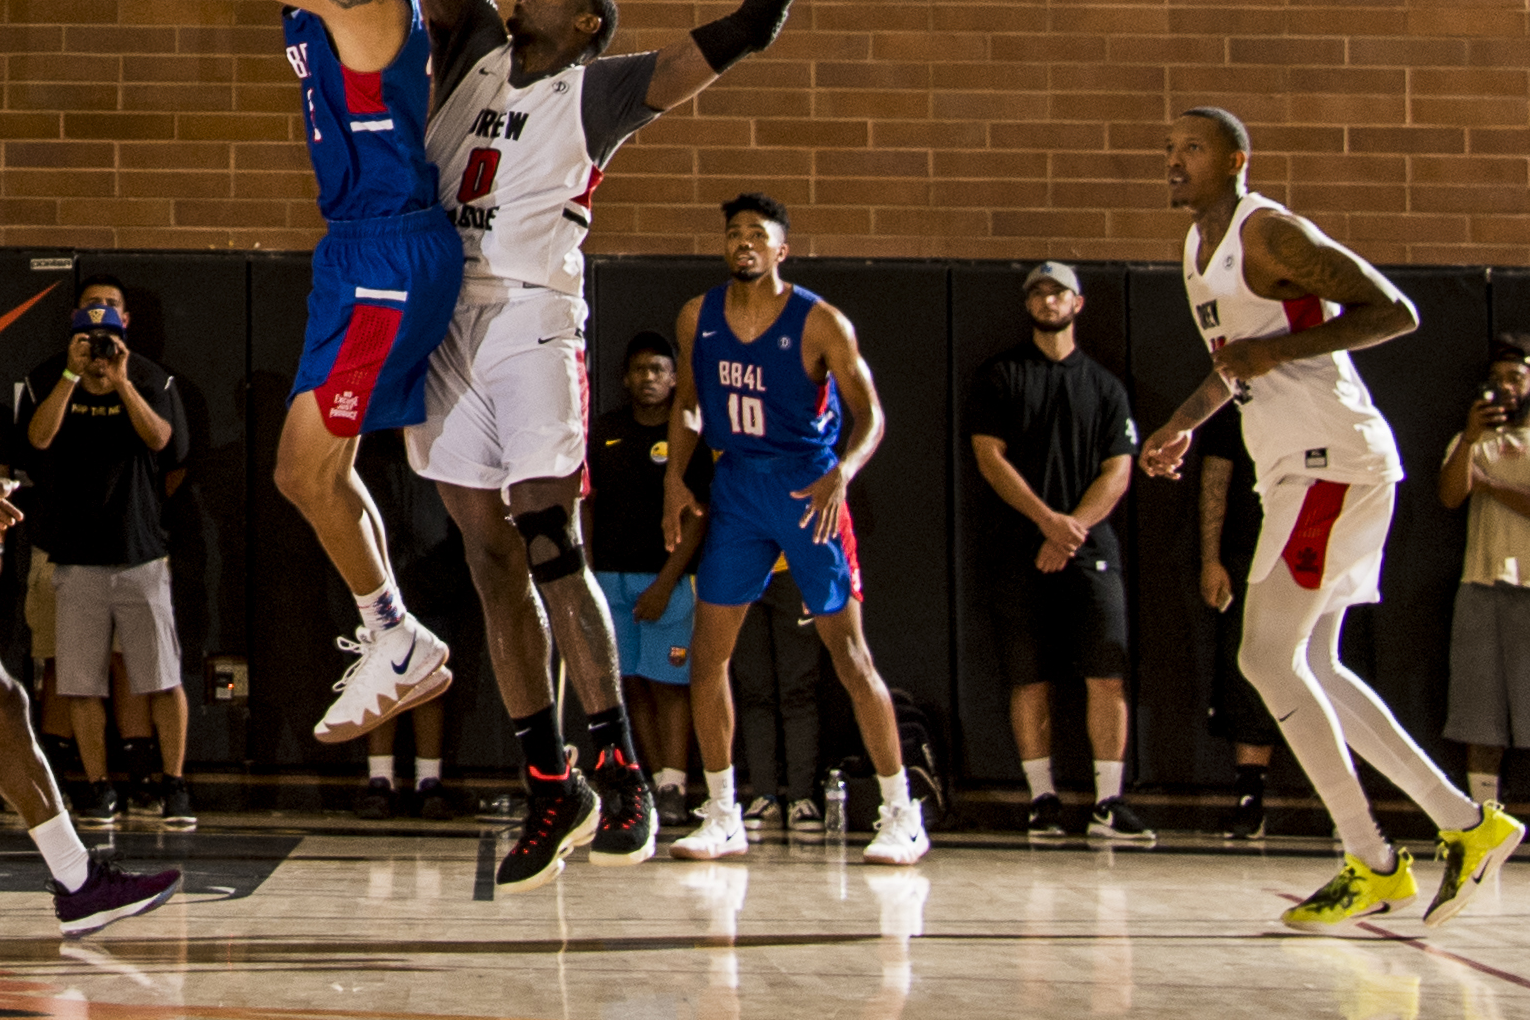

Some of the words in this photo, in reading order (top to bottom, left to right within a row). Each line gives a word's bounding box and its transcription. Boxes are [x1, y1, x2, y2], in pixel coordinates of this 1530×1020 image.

[456, 147, 502, 205] 0
[718, 360, 768, 391] BB4L
[727, 393, 767, 437] 10
